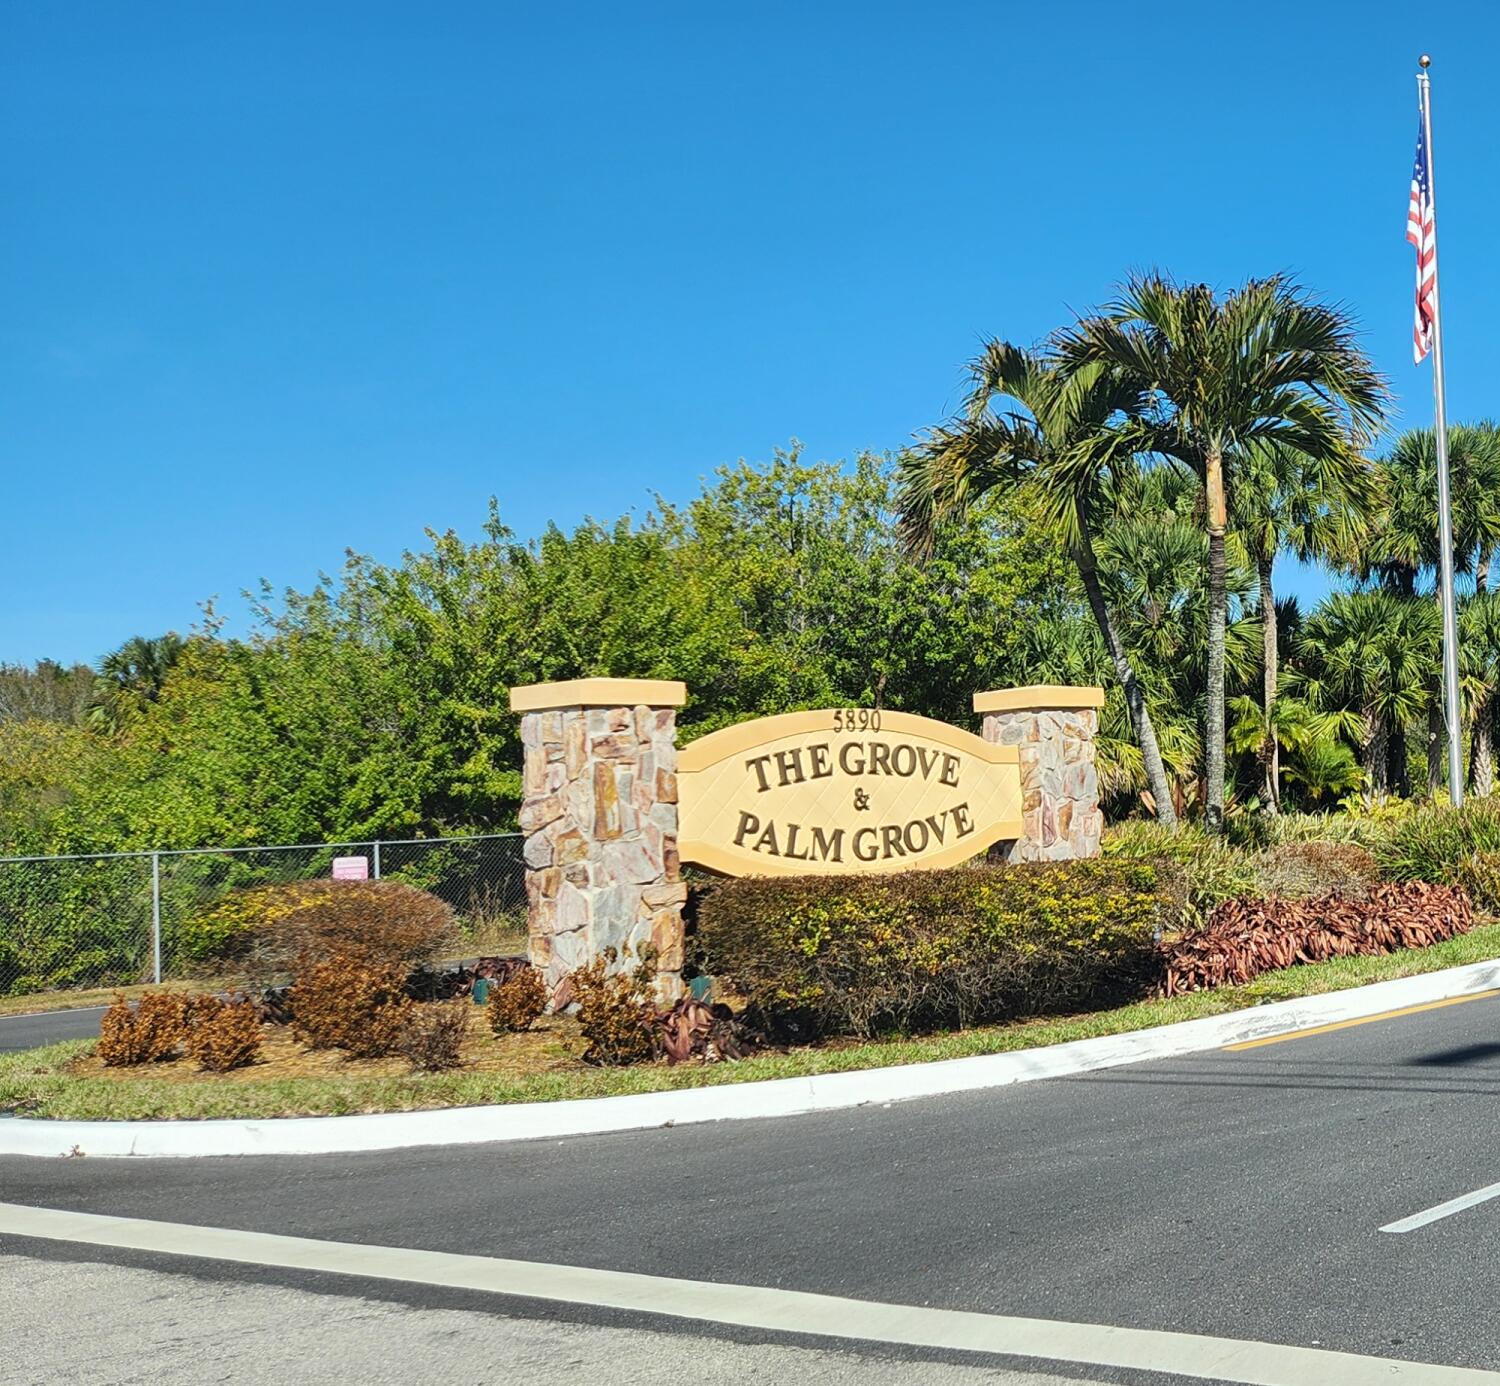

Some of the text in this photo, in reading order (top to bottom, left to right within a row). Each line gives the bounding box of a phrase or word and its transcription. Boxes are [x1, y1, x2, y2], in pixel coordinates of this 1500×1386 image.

[833, 709, 881, 733] 5890
[746, 742, 960, 793] THE GROVE
[853, 787, 870, 811] &
[733, 802, 974, 863] PALM GROVE
